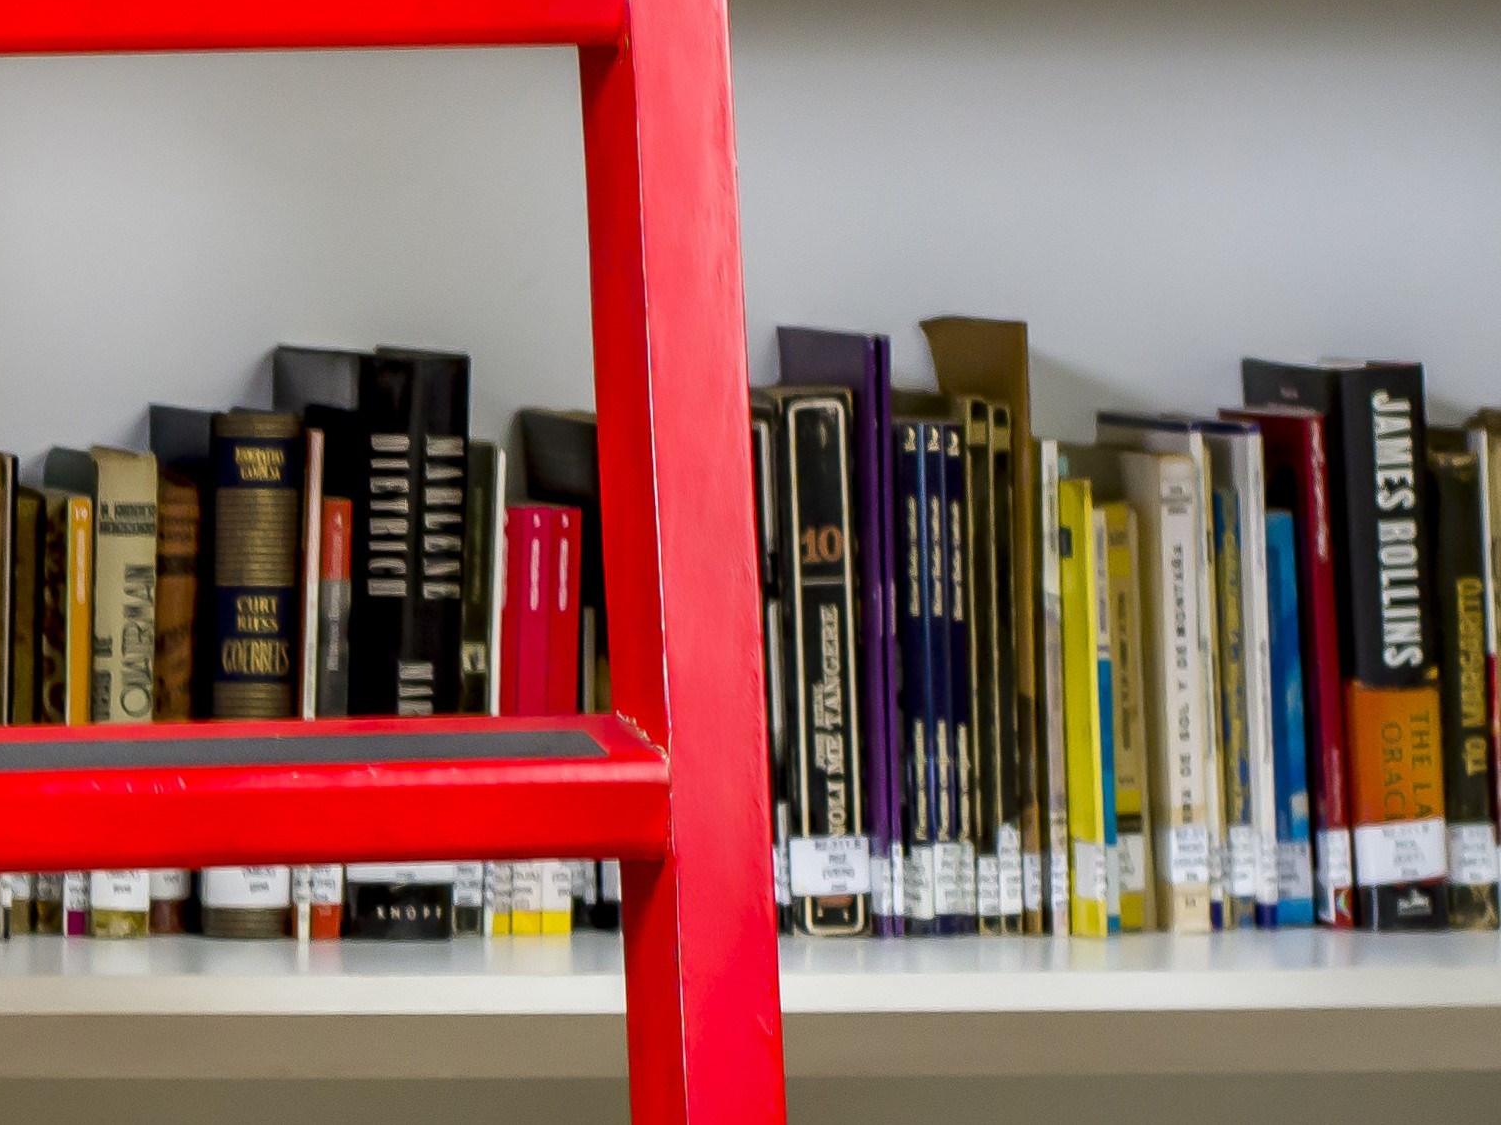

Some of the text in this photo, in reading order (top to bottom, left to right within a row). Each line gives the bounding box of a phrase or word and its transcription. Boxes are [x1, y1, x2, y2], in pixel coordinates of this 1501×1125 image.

[367, 433, 411, 596] DIETRICH
[422, 435, 464, 600] MARLENE
[802, 524, 845, 564] 10
[1370, 389, 1424, 670] JAMES ROLLINS
[237, 595, 279, 614] CURT
[1408, 710, 1434, 768] THE
